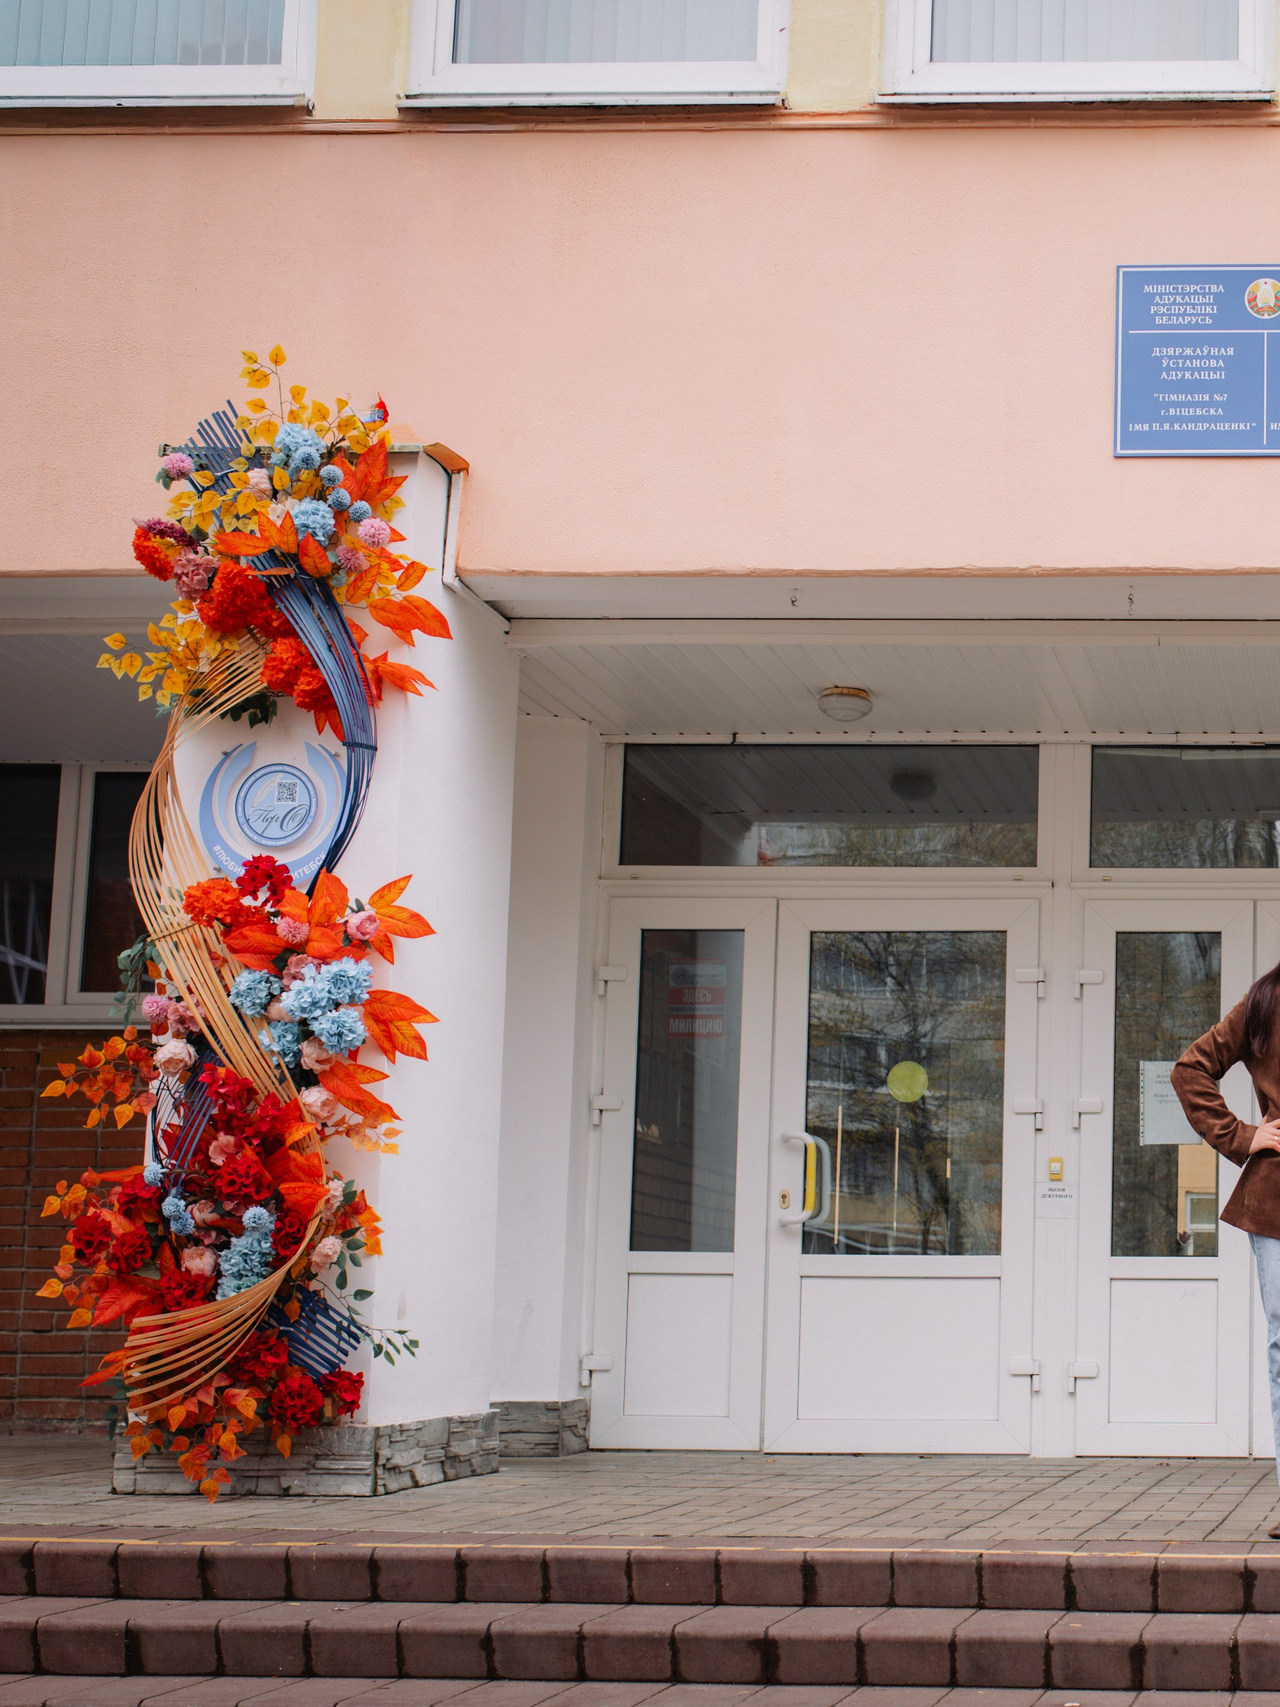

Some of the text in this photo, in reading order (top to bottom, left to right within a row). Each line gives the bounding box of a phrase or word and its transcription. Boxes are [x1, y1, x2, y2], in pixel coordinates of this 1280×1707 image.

[1143, 284, 1225, 293] МІНІСТЭРСТВА
[1153, 295, 1214, 304] АДУКАЦЫІ
[1149, 305, 1218, 314] РЭСПУБЛІКІ
[1154, 315, 1213, 324] БЕЛАРУСЬ
[1151, 346, 1235, 357] ДЗЯРЖАЎНАЯ
[1161, 357, 1225, 367] ЎСТАНОВА
[1160, 371, 1226, 380] АДУКАЦЫІ
[1128, 423, 1150, 432] ІМЯ
[682, 988, 712, 1004] ЗДЕСЬ
[669, 1018, 723, 1036] МИЛИЦИЮ
